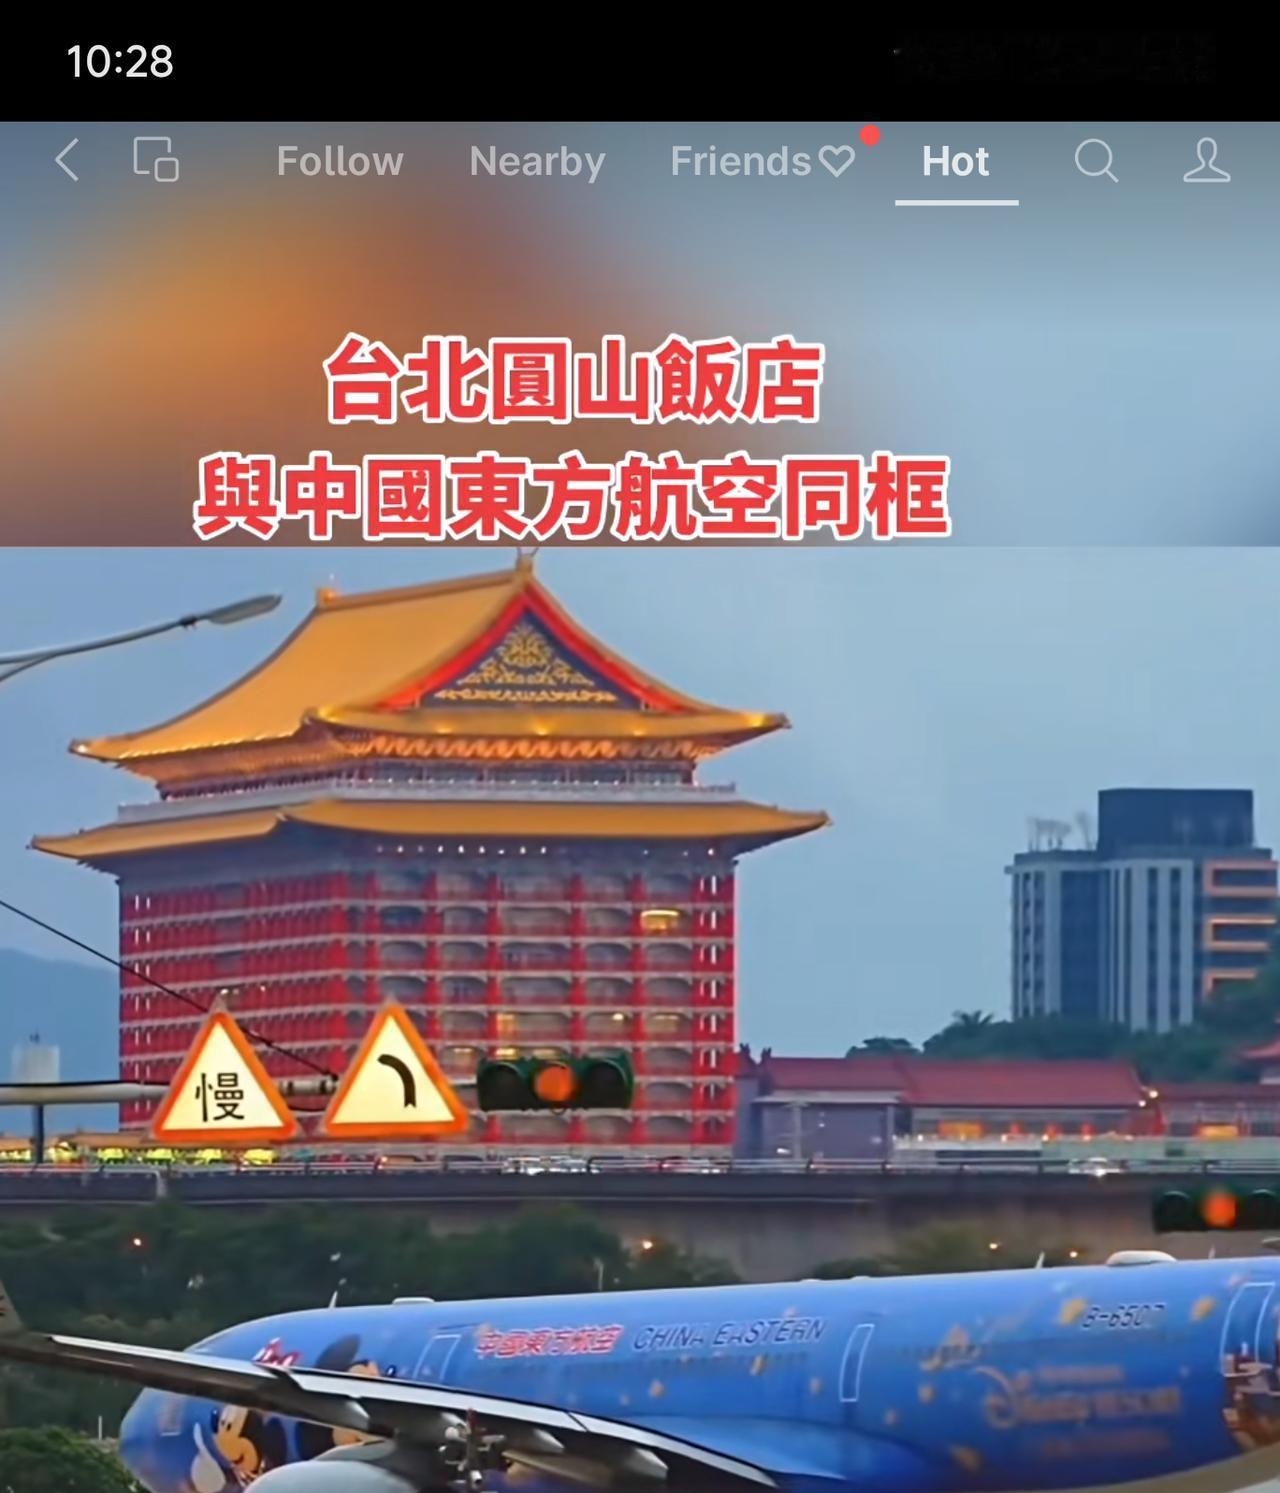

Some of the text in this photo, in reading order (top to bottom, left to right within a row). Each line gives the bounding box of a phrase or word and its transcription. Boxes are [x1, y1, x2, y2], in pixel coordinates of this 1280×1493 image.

[195, 1072, 245, 1122] 慢
[633, 1323, 704, 1351] CHINA
[712, 1317, 828, 1347] EASTERN
